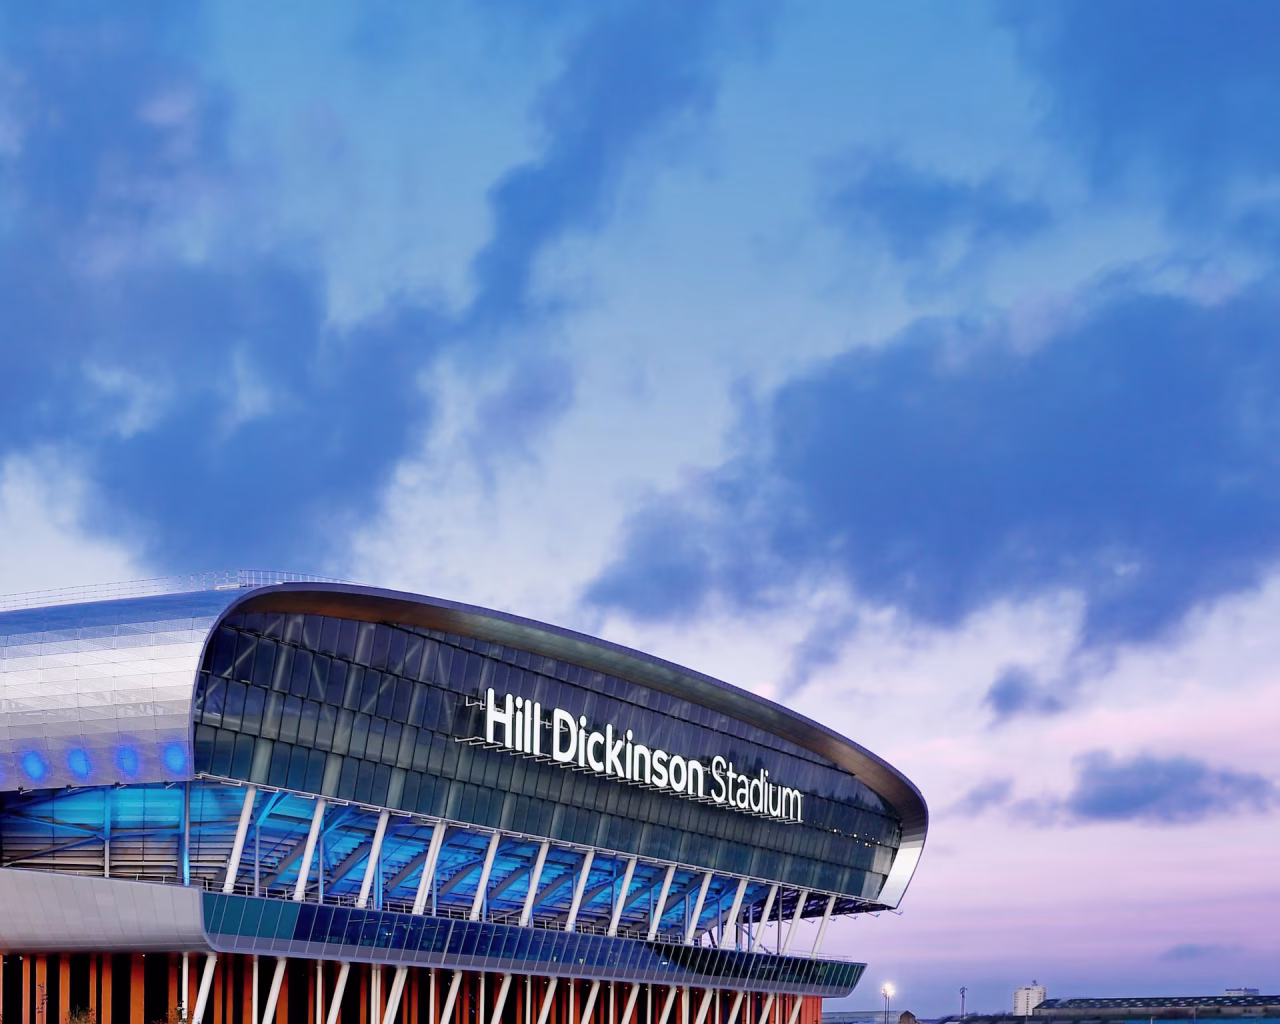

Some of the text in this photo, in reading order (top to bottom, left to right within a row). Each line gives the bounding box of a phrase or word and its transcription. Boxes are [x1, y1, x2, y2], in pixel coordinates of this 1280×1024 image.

[486, 687, 802, 823] Hill Dickinson Stadium
